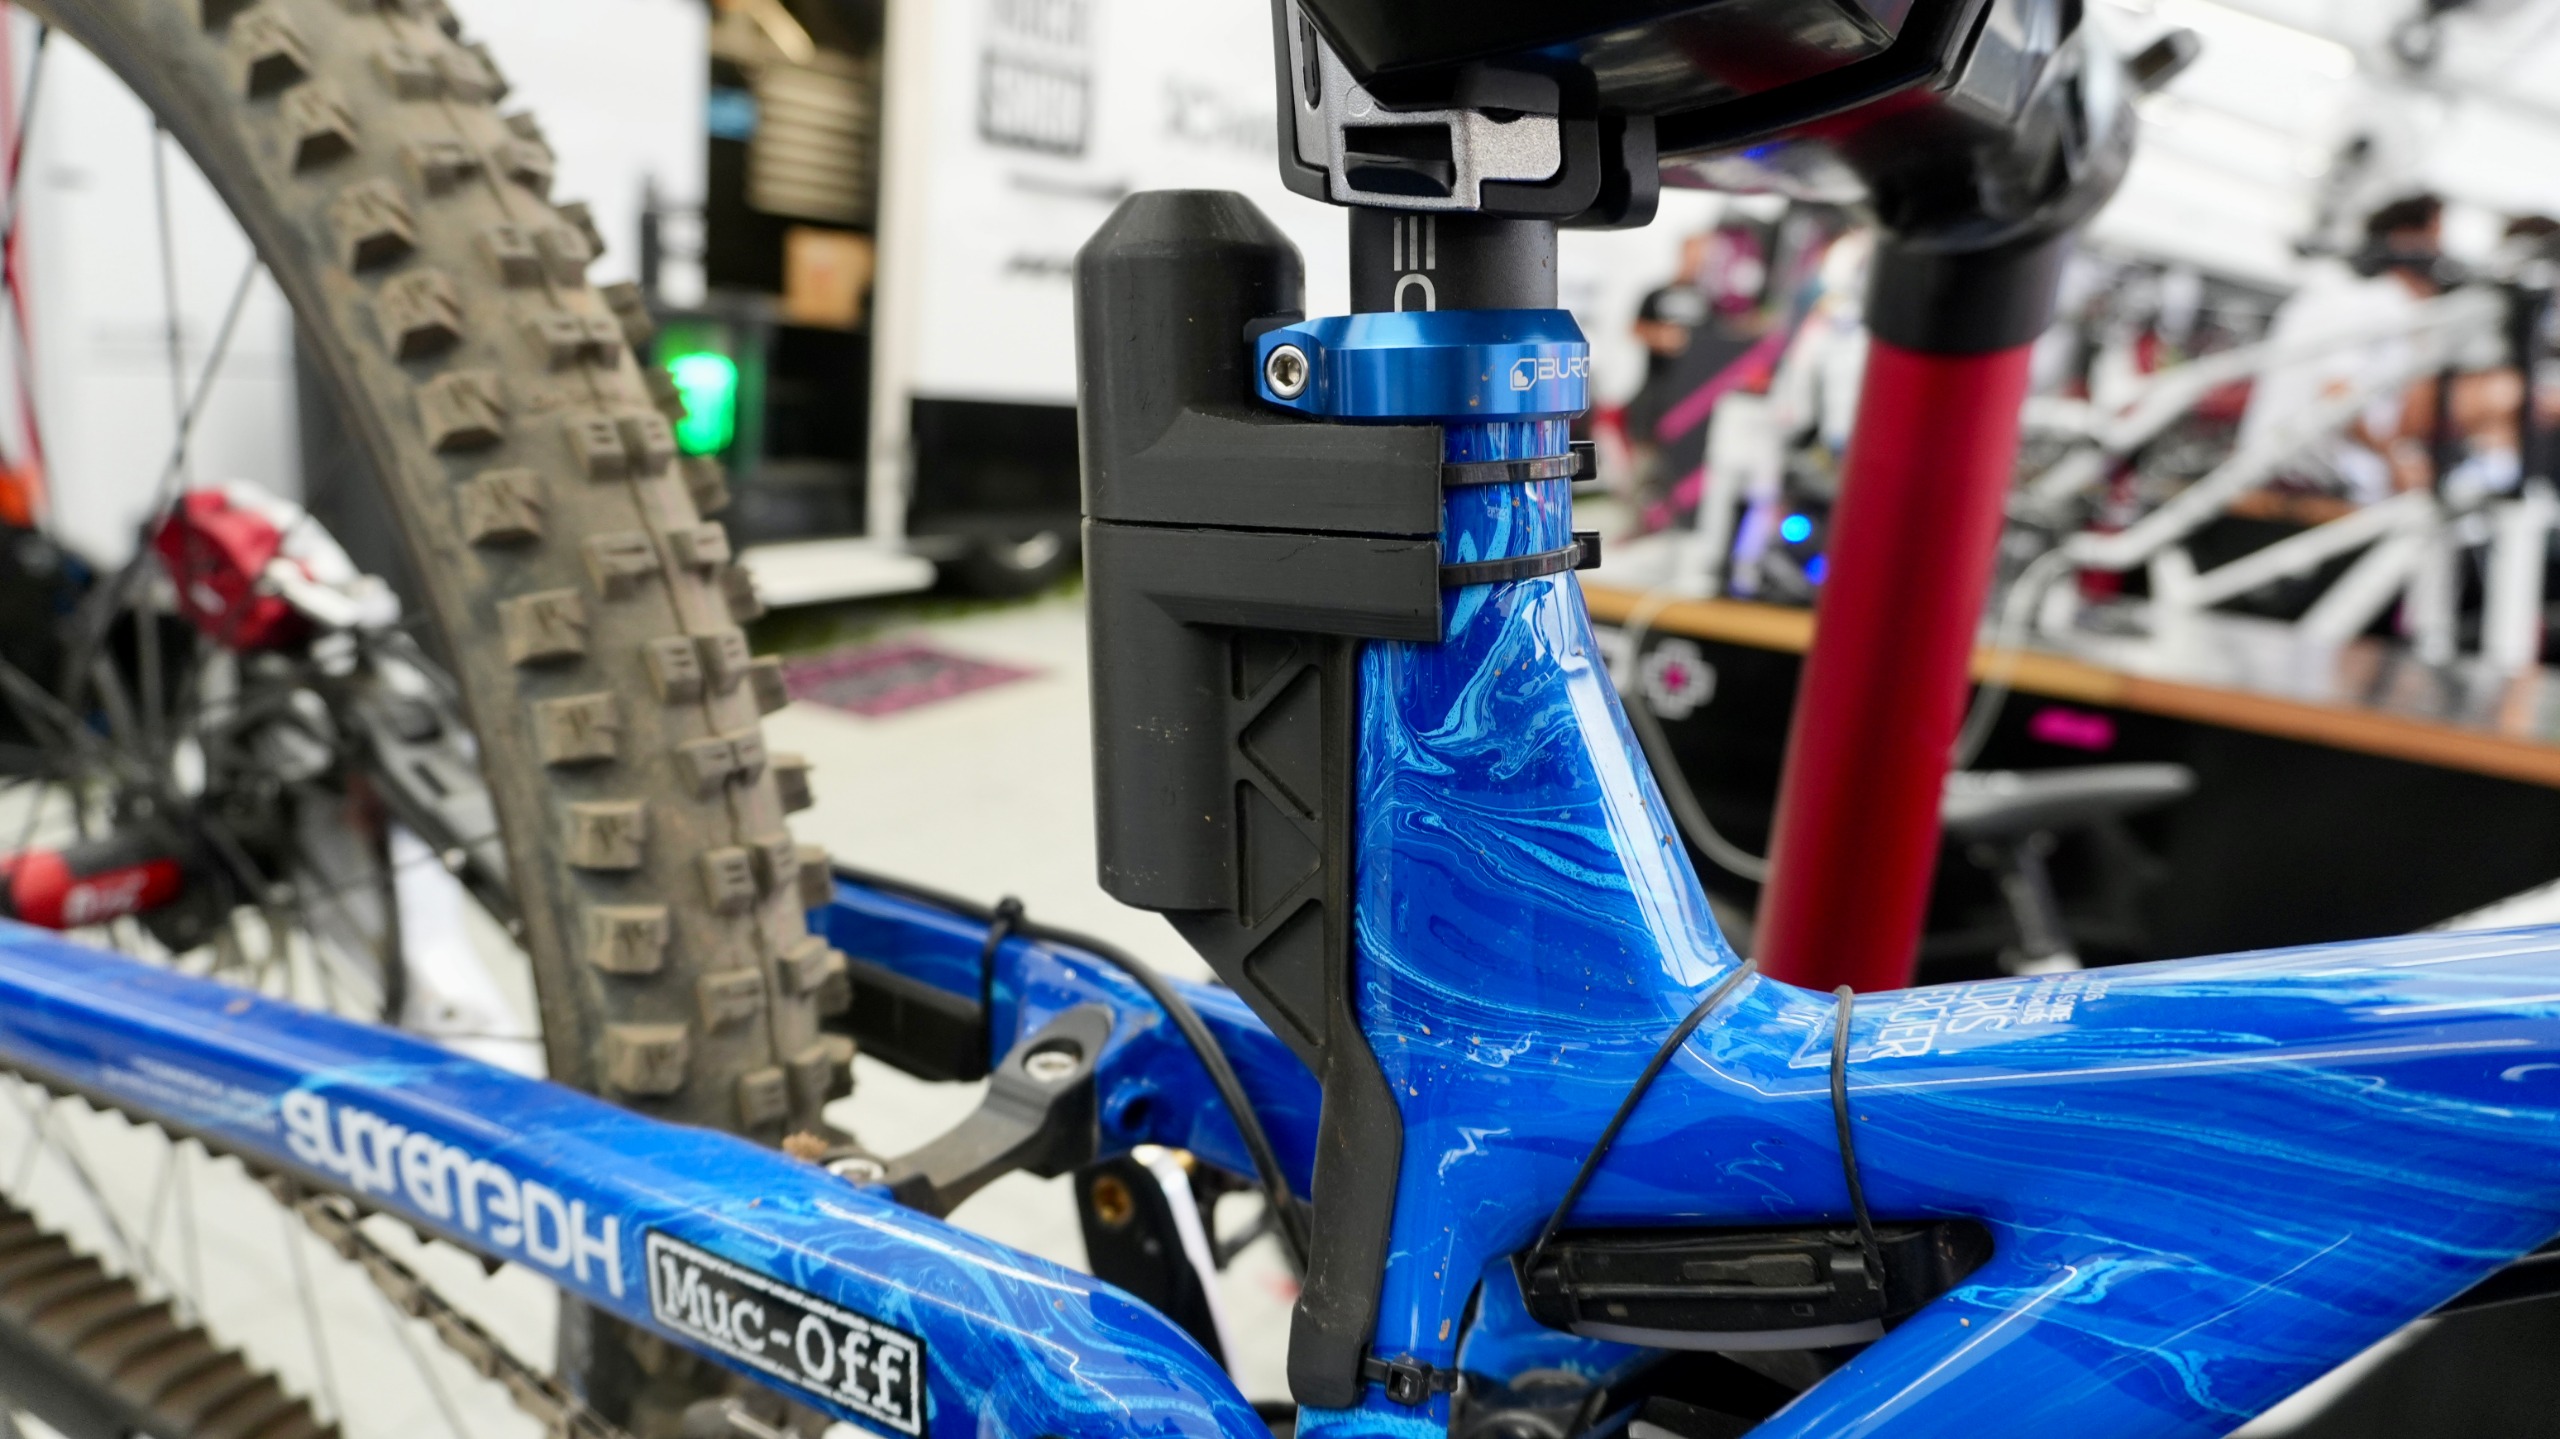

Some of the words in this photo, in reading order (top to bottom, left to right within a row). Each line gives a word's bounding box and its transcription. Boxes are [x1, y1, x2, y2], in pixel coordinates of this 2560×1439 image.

[1538, 356, 1590, 380] BURG
[1870, 985, 1964, 1058] ERGIER
[660, 1253, 904, 1416] Muc-Off
